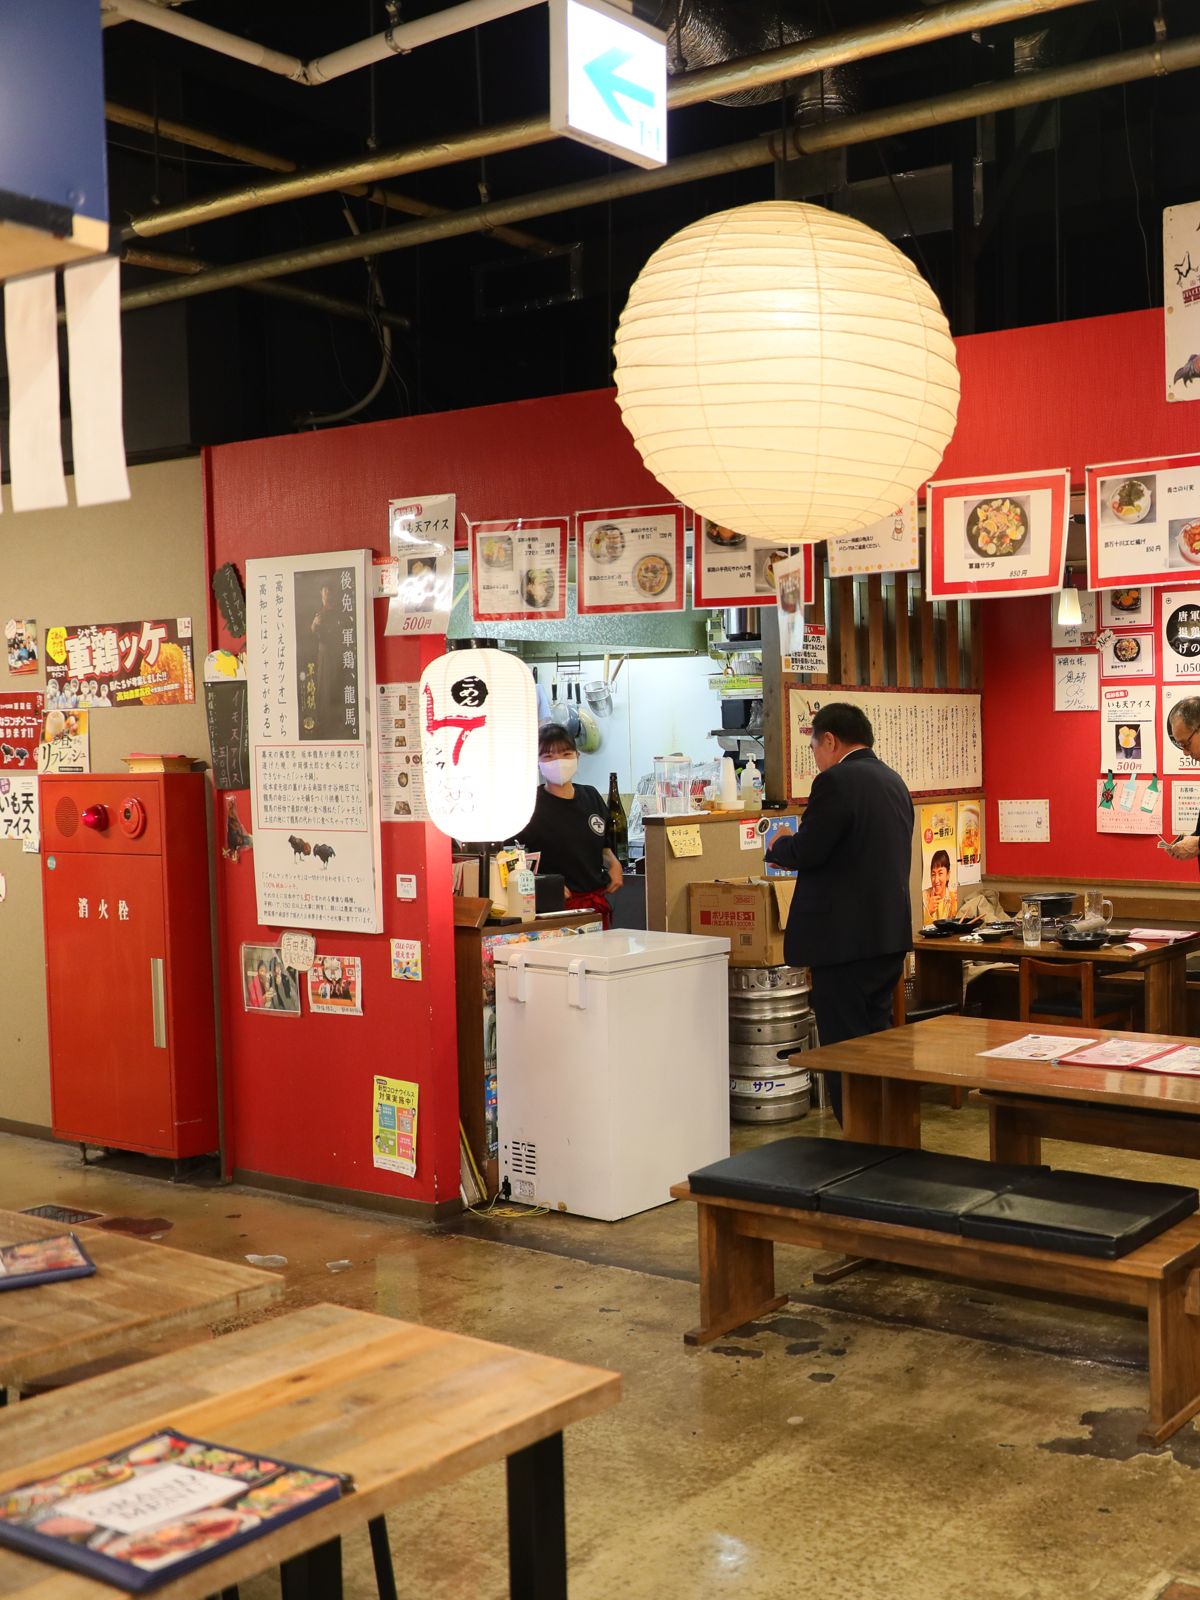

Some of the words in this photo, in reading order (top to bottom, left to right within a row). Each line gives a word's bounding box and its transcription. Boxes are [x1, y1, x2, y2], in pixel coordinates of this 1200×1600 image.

[258, 574, 272, 739] 「高知にはシャモがある」
[274, 574, 287, 738] 「高知といえばカツオ」から
[340, 571, 357, 735] 後免、軍鶏、龍馬。
[459, 676, 480, 707] ごめん
[1107, 700, 1151, 708] いも天アイス
[42, 743, 87, 773] リフレッシュ
[3, 817, 32, 836] アイス
[78, 897, 129, 920] 消火栓
[753, 1081, 785, 1092] サワー
